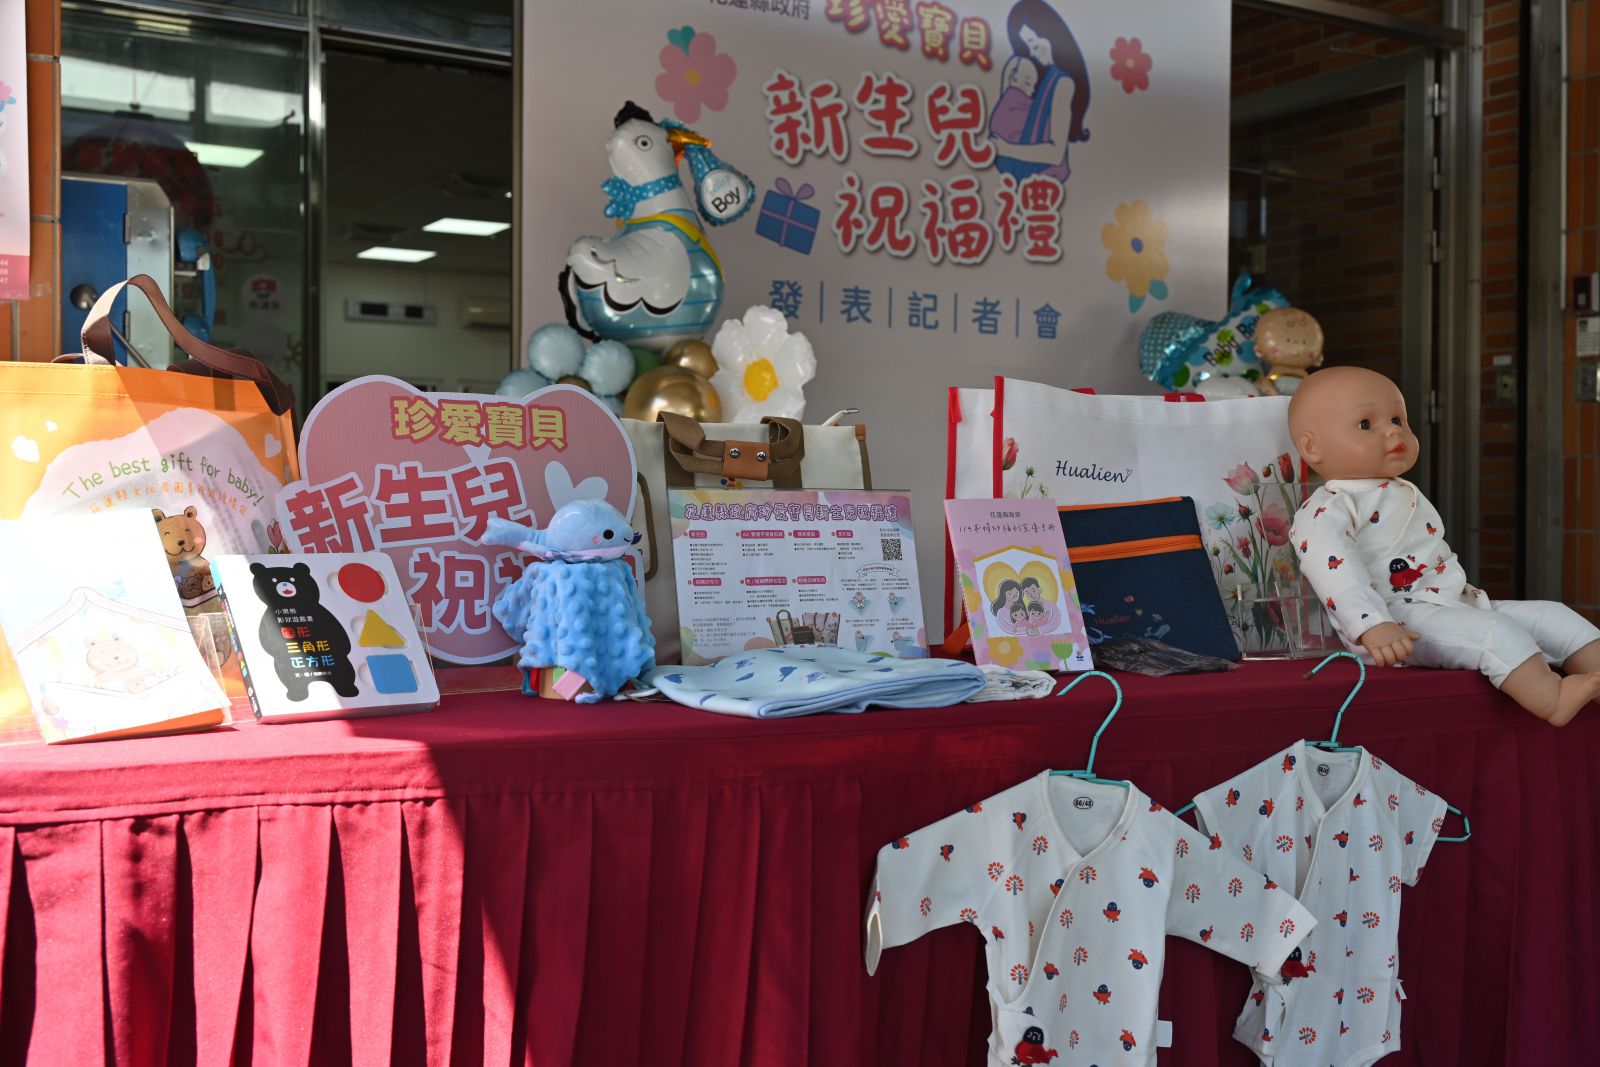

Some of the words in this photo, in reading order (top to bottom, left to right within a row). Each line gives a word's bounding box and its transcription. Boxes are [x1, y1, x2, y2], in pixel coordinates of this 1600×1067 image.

[825, 0, 993, 69] 珍愛寶貝
[763, 70, 997, 168] 新生兒
[711, 187, 740, 213] Boy
[832, 174, 1064, 265] 祝福禮
[391, 396, 569, 452] 珍愛寶貝
[62, 470, 103, 500] The
[109, 456, 151, 479] best
[160, 454, 194, 474] gift
[200, 456, 221, 479] for
[226, 467, 265, 507] baby!
[1055, 459, 1128, 483] Hualien
[285, 459, 533, 554] 新生兒
[285, 640, 331, 653] 三角形
[290, 655, 335, 668] 正方形
